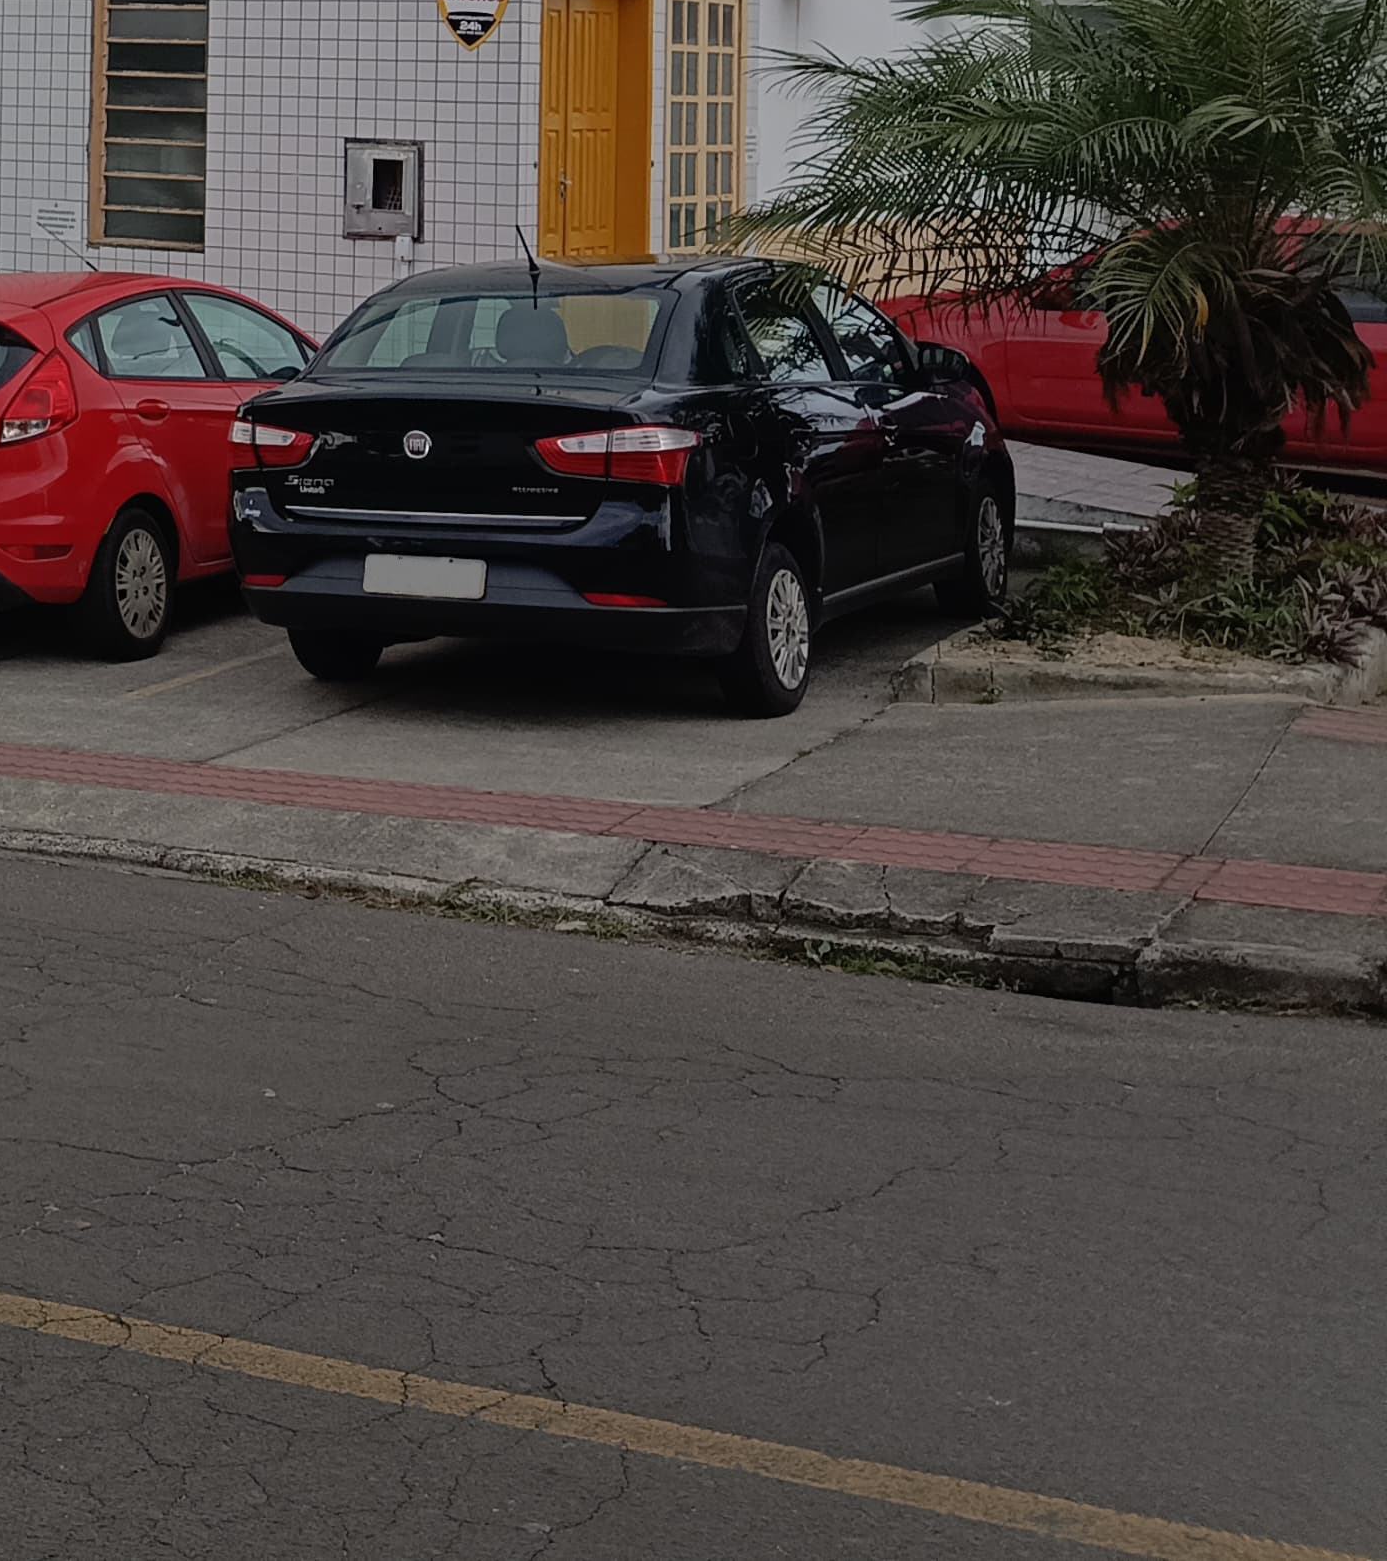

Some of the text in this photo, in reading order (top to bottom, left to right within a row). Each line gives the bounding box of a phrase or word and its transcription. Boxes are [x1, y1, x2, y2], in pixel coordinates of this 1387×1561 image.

[459, 20, 482, 31] 24h
[408, 438, 426, 452] FIAT
[284, 474, 335, 487] Siena
